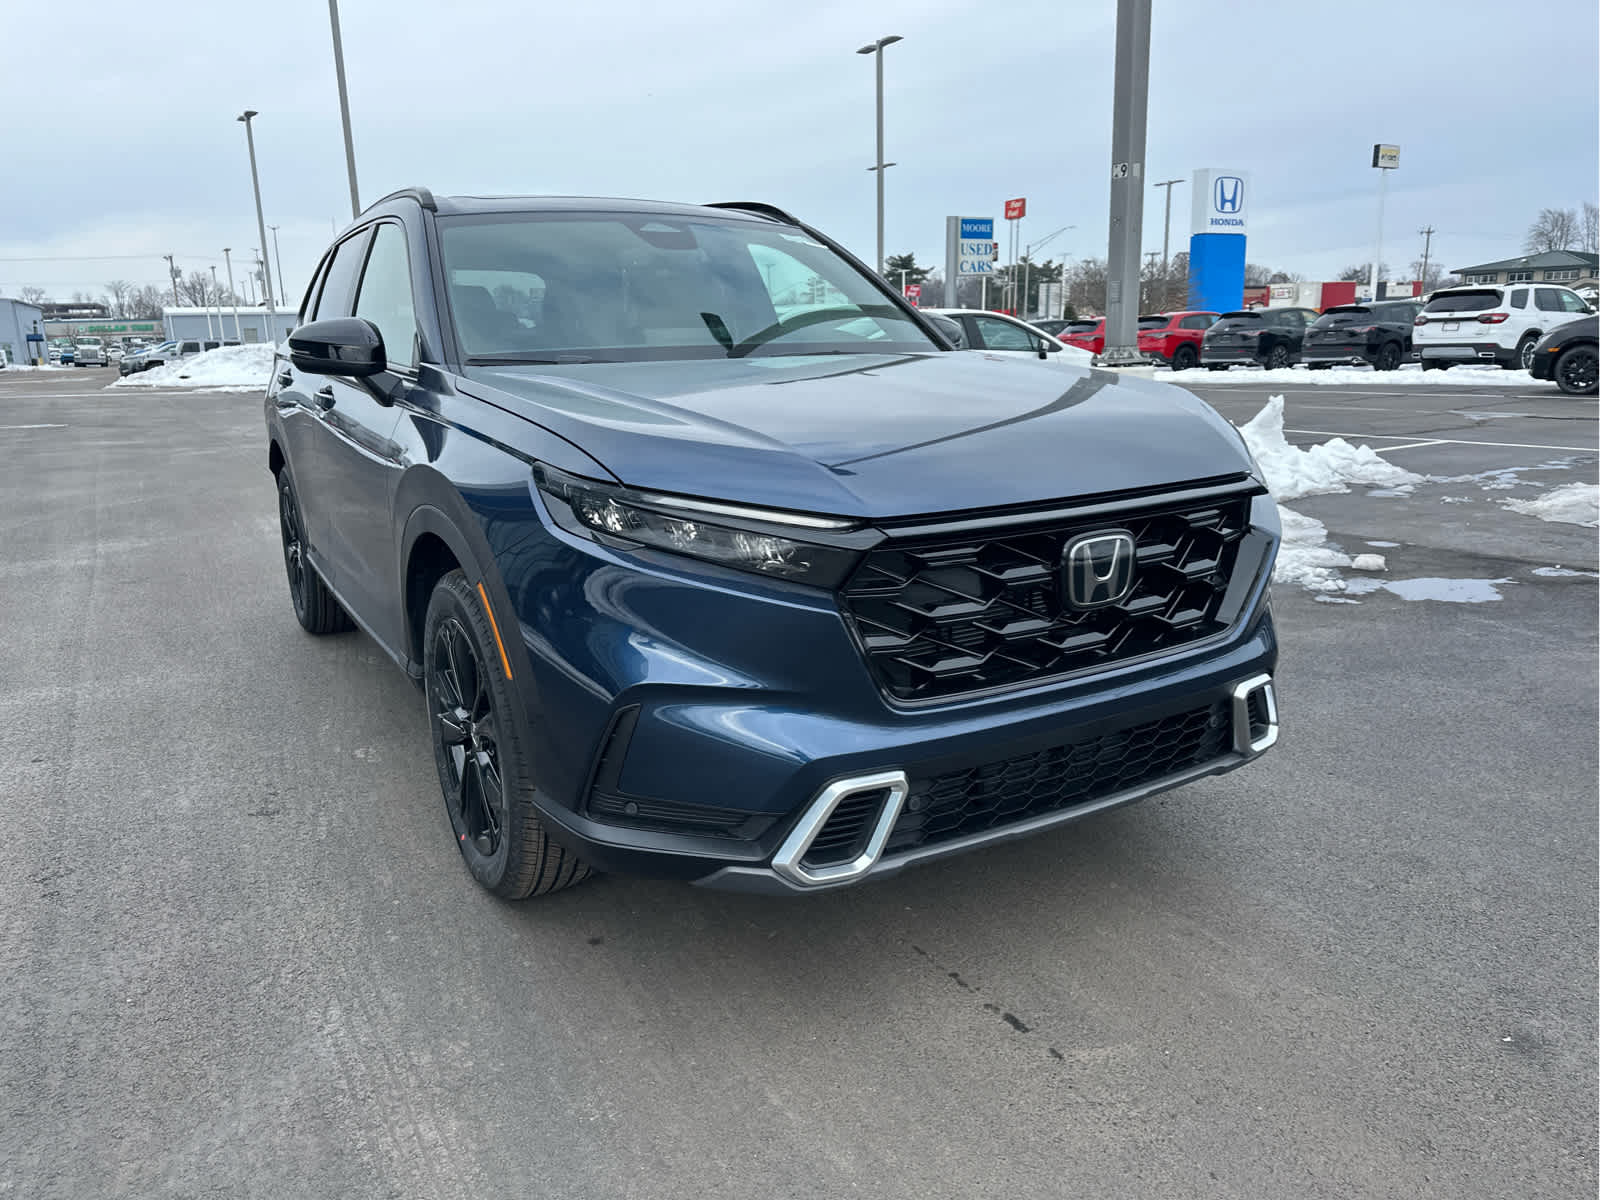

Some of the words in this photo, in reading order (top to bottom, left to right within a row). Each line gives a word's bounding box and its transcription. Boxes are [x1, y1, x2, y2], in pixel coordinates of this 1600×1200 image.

[962, 223, 992, 232] MOORE
[1210, 218, 1244, 226] HONDA
[960, 243, 993, 256] USED
[960, 260, 993, 273] CARS
